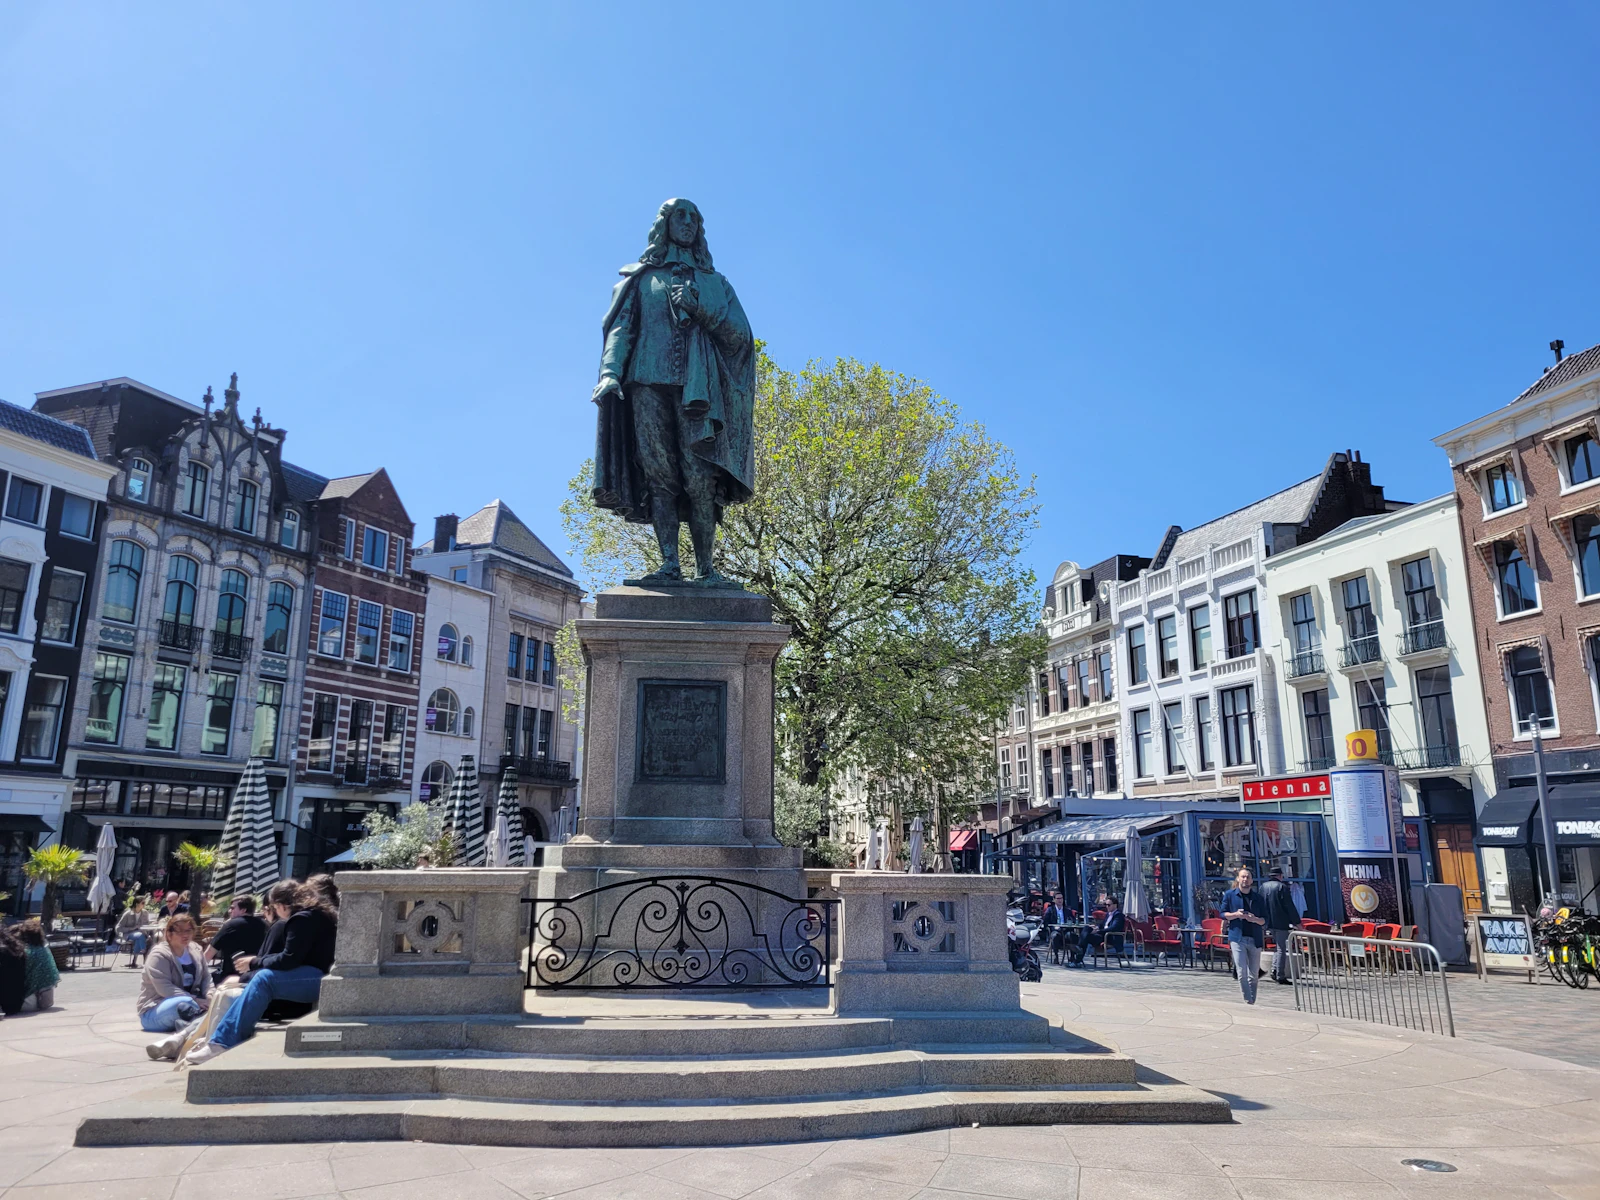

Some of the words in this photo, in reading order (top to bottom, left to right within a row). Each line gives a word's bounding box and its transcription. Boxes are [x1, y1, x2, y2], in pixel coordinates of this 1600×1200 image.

[1246, 781, 1327, 797] vienna
[1482, 826, 1520, 836] TONI&GUY
[1344, 864, 1381, 879] VIENNA
[1480, 920, 1527, 937] TAKE
[1485, 938, 1528, 954] AWAY
